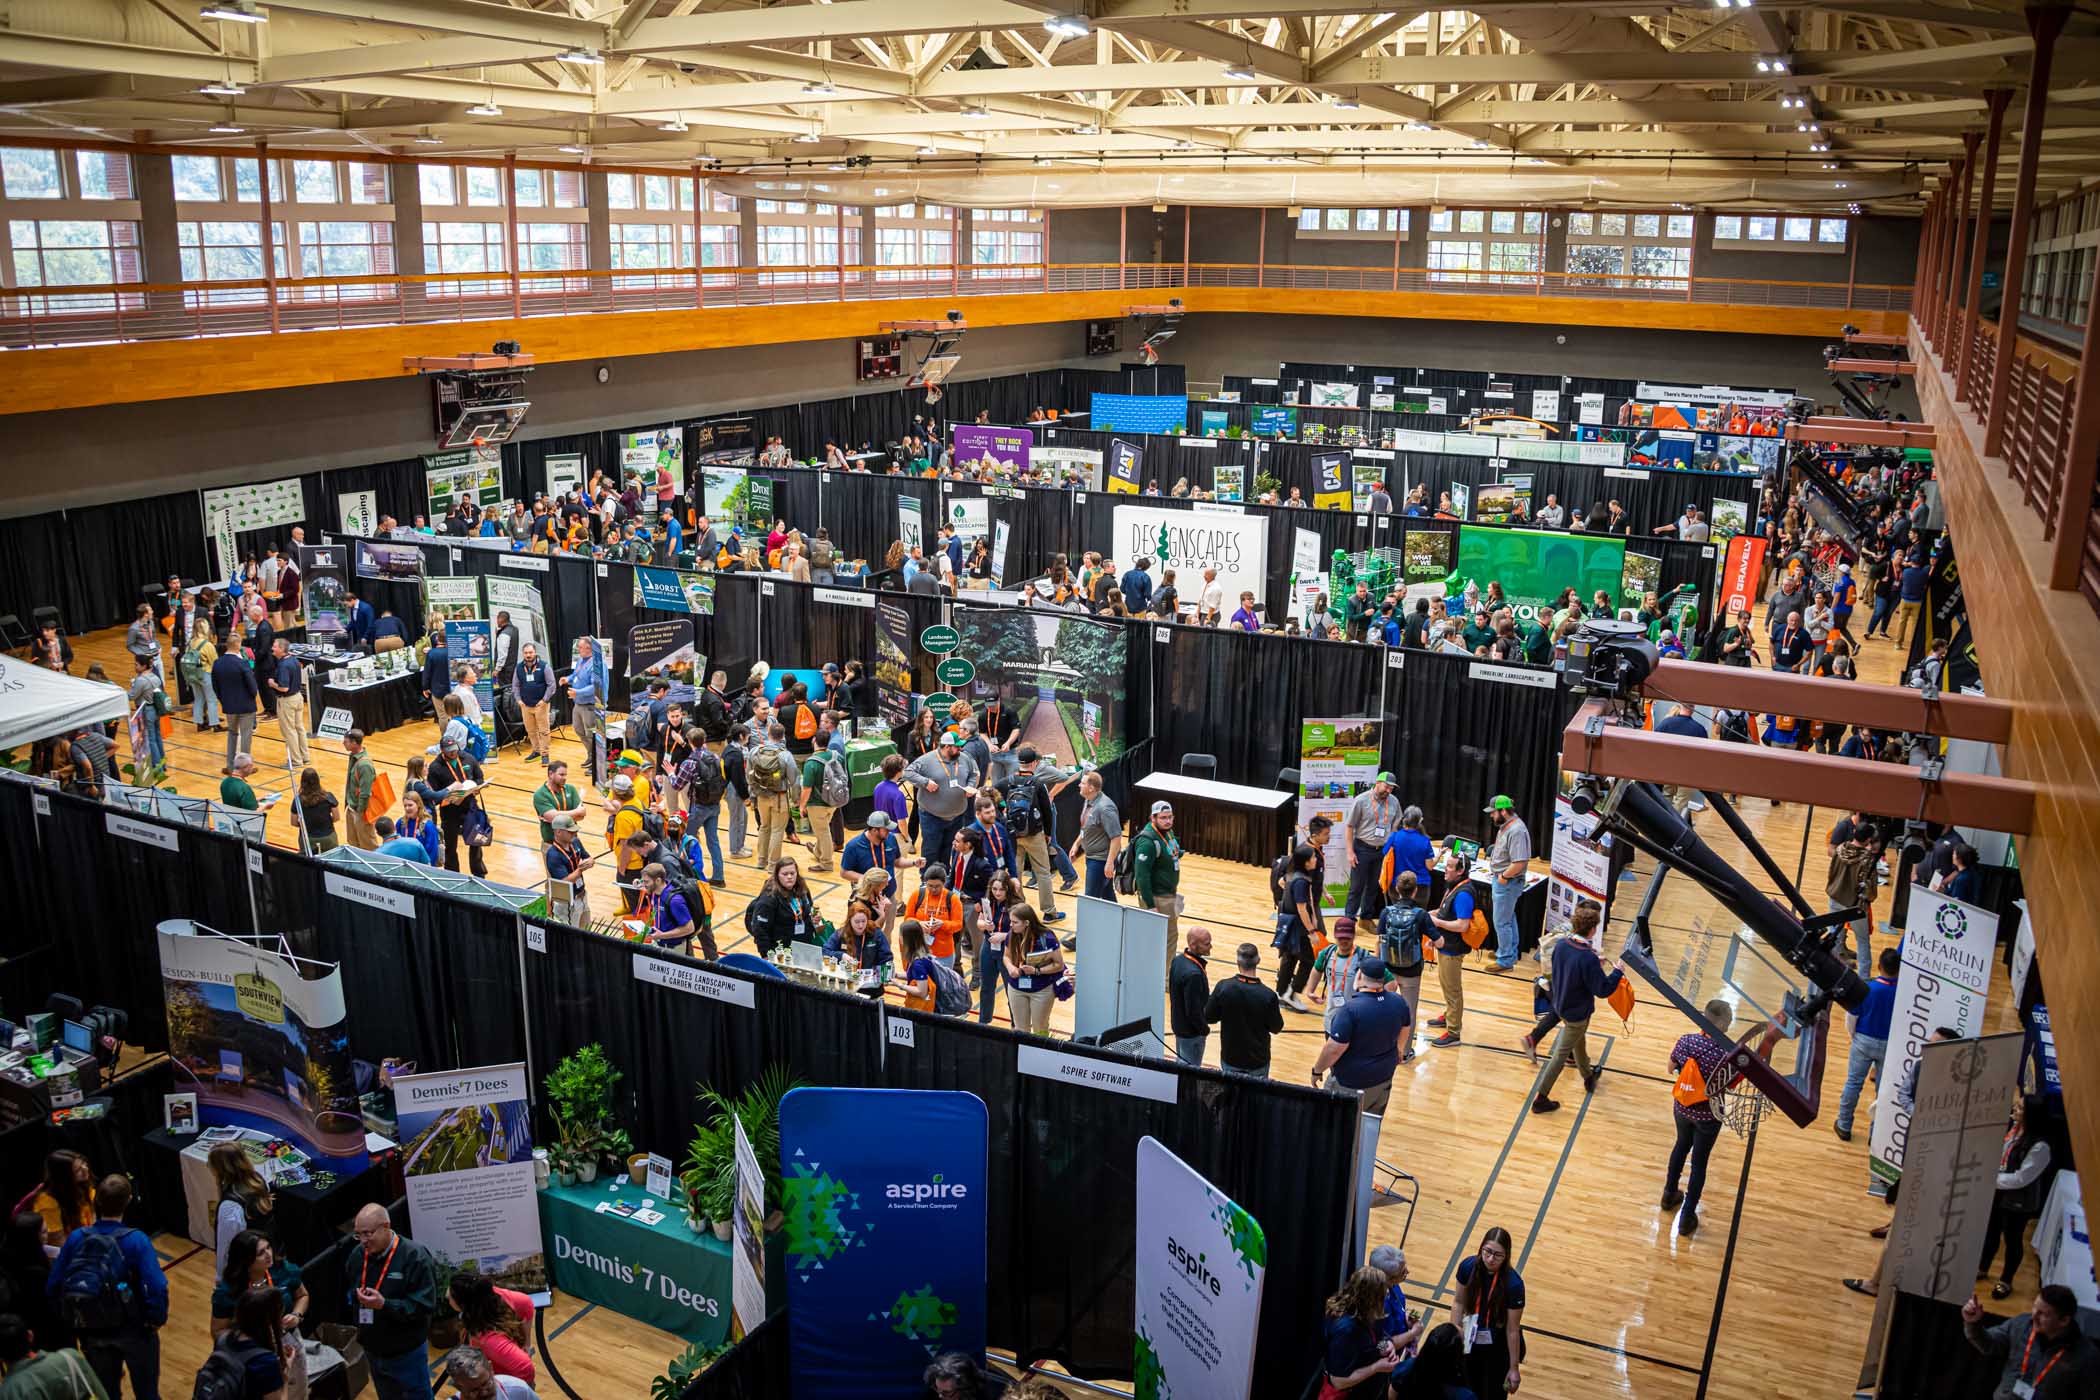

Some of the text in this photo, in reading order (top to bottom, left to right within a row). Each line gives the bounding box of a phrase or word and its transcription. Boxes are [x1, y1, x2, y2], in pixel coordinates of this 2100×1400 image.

[637, 437, 654, 446] GROW
[1008, 445, 1020, 453] RULE
[1117, 446, 1135, 479] CAT
[1322, 456, 1342, 490] CAT
[225, 509, 236, 571] eenscaping
[903, 522, 919, 545] ISA
[1412, 554, 1433, 562] WHAT
[1736, 539, 1752, 592] GRAVELY
[1408, 565, 1446, 576] OFFER
[655, 584, 680, 593] BORST
[1628, 578, 1645, 586] WHAT
[1634, 584, 1643, 592] WE
[1625, 588, 1644, 600] OFF
[1158, 630, 1169, 641] 205
[635, 646, 663, 655] Landscapes
[1390, 655, 1403, 665] 203
[1002, 661, 1037, 670] MARIANI
[1479, 670, 1504, 678] TIMBERLINE
[333, 711, 352, 723] ECL
[251, 855, 261, 867] 107
[343, 885, 396, 906] SOUTHVIEW DESIGN, INC
[529, 931, 542, 945] 105
[1909, 931, 1985, 973] McFARLIN
[649, 963, 736, 992] DENNIS 7 DEES LANDSCAPING
[1907, 949, 1982, 988] STANFORD
[669, 977, 692, 990] GARDEN
[694, 983, 721, 997] CENTERS
[239, 986, 281, 1009] SOUTHVIEW
[893, 1024, 911, 1040] 103
[1061, 1065, 1133, 1088] ASPIRE SOFTWARE
[1884, 973, 1940, 1167] Booeeping
[464, 1082, 471, 1093] 7
[475, 1079, 509, 1091] Dees
[886, 1173, 968, 1203] aspire
[1168, 1236, 1221, 1297] aspire
[641, 1270, 655, 1291] 7
[661, 1275, 720, 1318] Dees
[1167, 1286, 1216, 1341] Comprehensive,
[1160, 1292, 1193, 1328] end-to-end
[1194, 1326, 1222, 1358] solutions
[1162, 1304, 1219, 1366] that empower your
[1167, 1321, 1212, 1372] entire business
